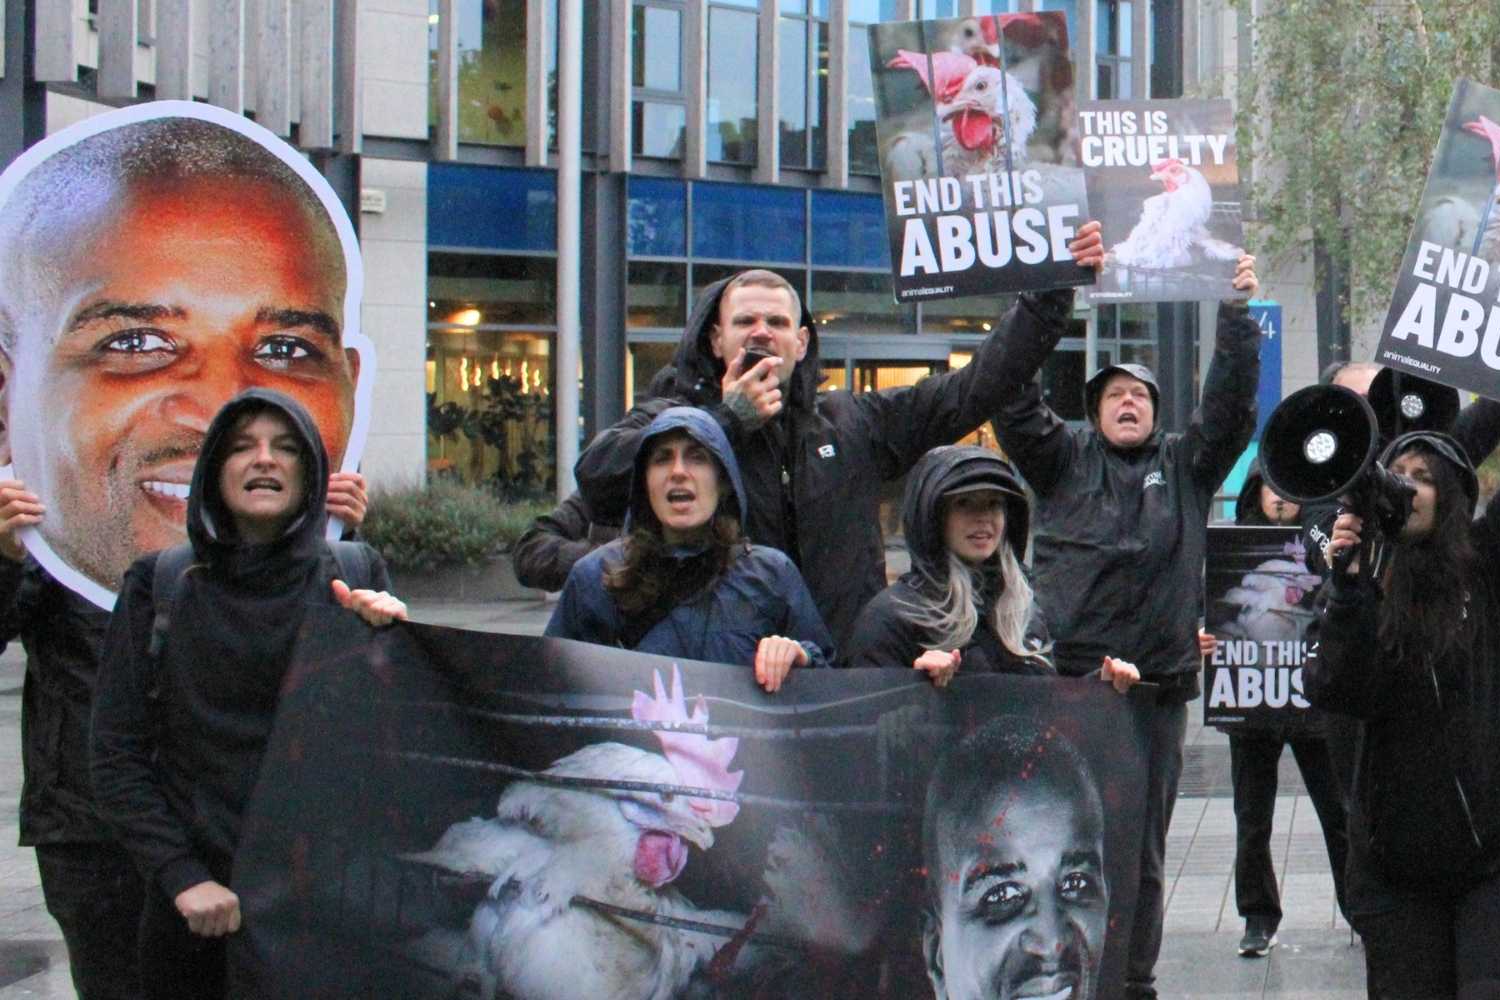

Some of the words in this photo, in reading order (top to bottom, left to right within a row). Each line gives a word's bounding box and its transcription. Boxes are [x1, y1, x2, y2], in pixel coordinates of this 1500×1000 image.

[1079, 110, 1137, 135] THIS
[1144, 110, 1169, 135] IS
[1081, 134, 1228, 167] CRUELTY
[894, 176, 962, 216] END
[966, 169, 1044, 209] THIS
[900, 203, 1079, 277] ABUSE
[1413, 240, 1490, 295] END
[1211, 639, 1258, 666] END
[1208, 667, 1312, 709] ABUS
